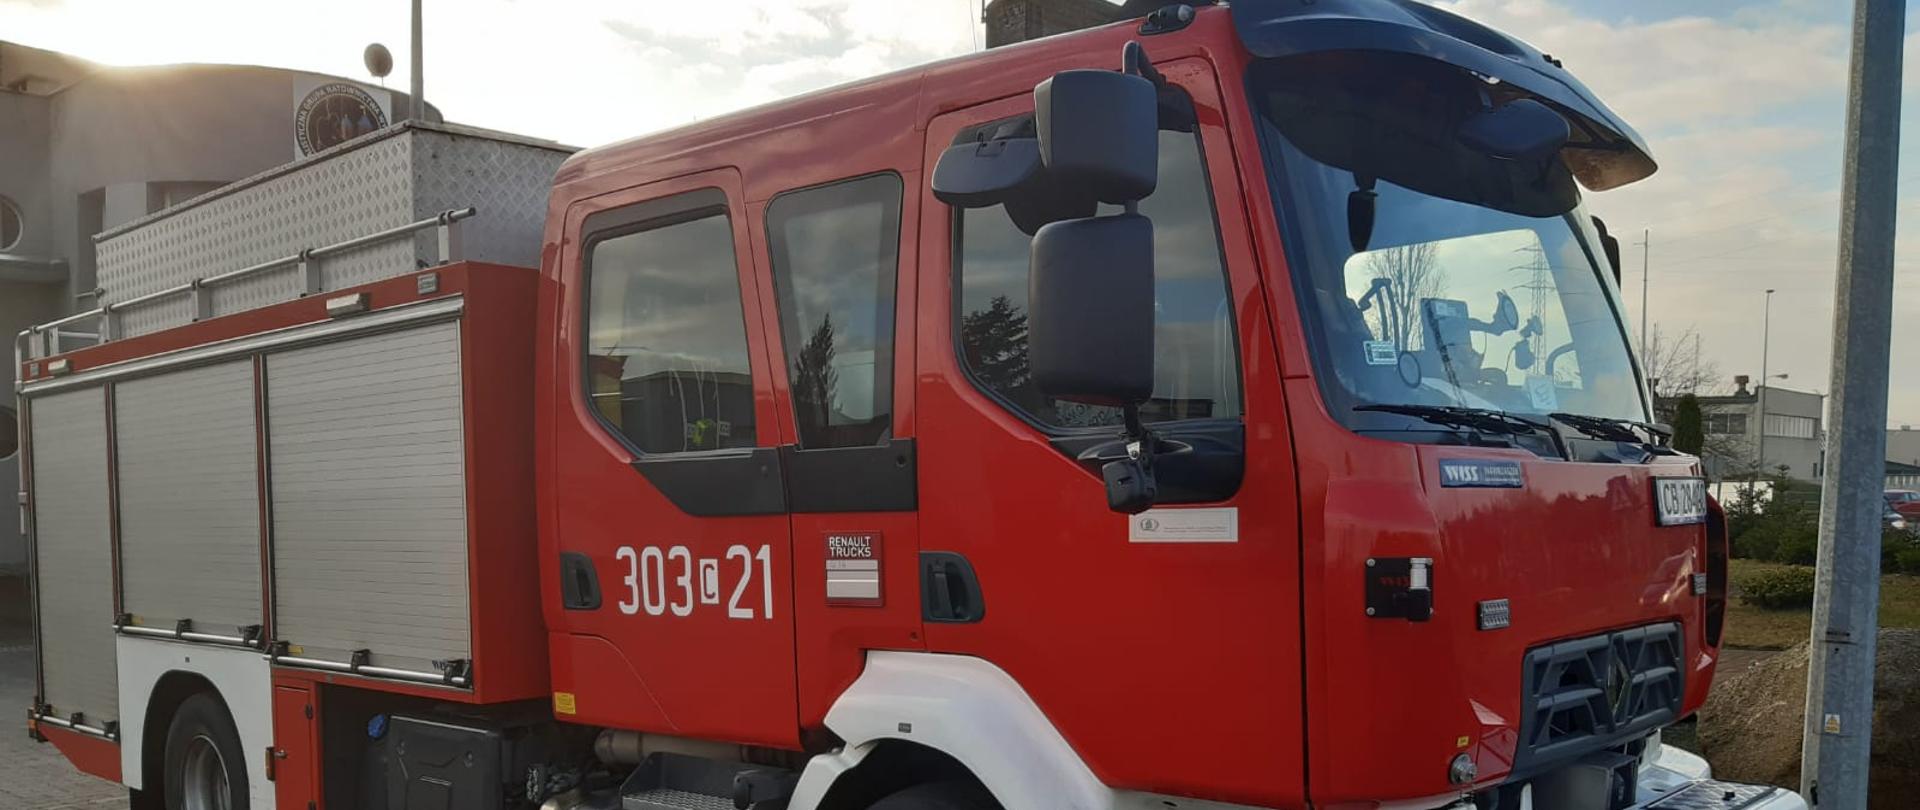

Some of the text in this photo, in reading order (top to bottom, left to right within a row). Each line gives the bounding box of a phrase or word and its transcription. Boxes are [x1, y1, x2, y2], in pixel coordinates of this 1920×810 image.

[1444, 465, 1479, 481] WISS
[1663, 483, 1679, 515] CB
[829, 536, 871, 547] RENAULT
[830, 547, 872, 557] TRUCKS
[615, 544, 774, 620] 303 C 21
